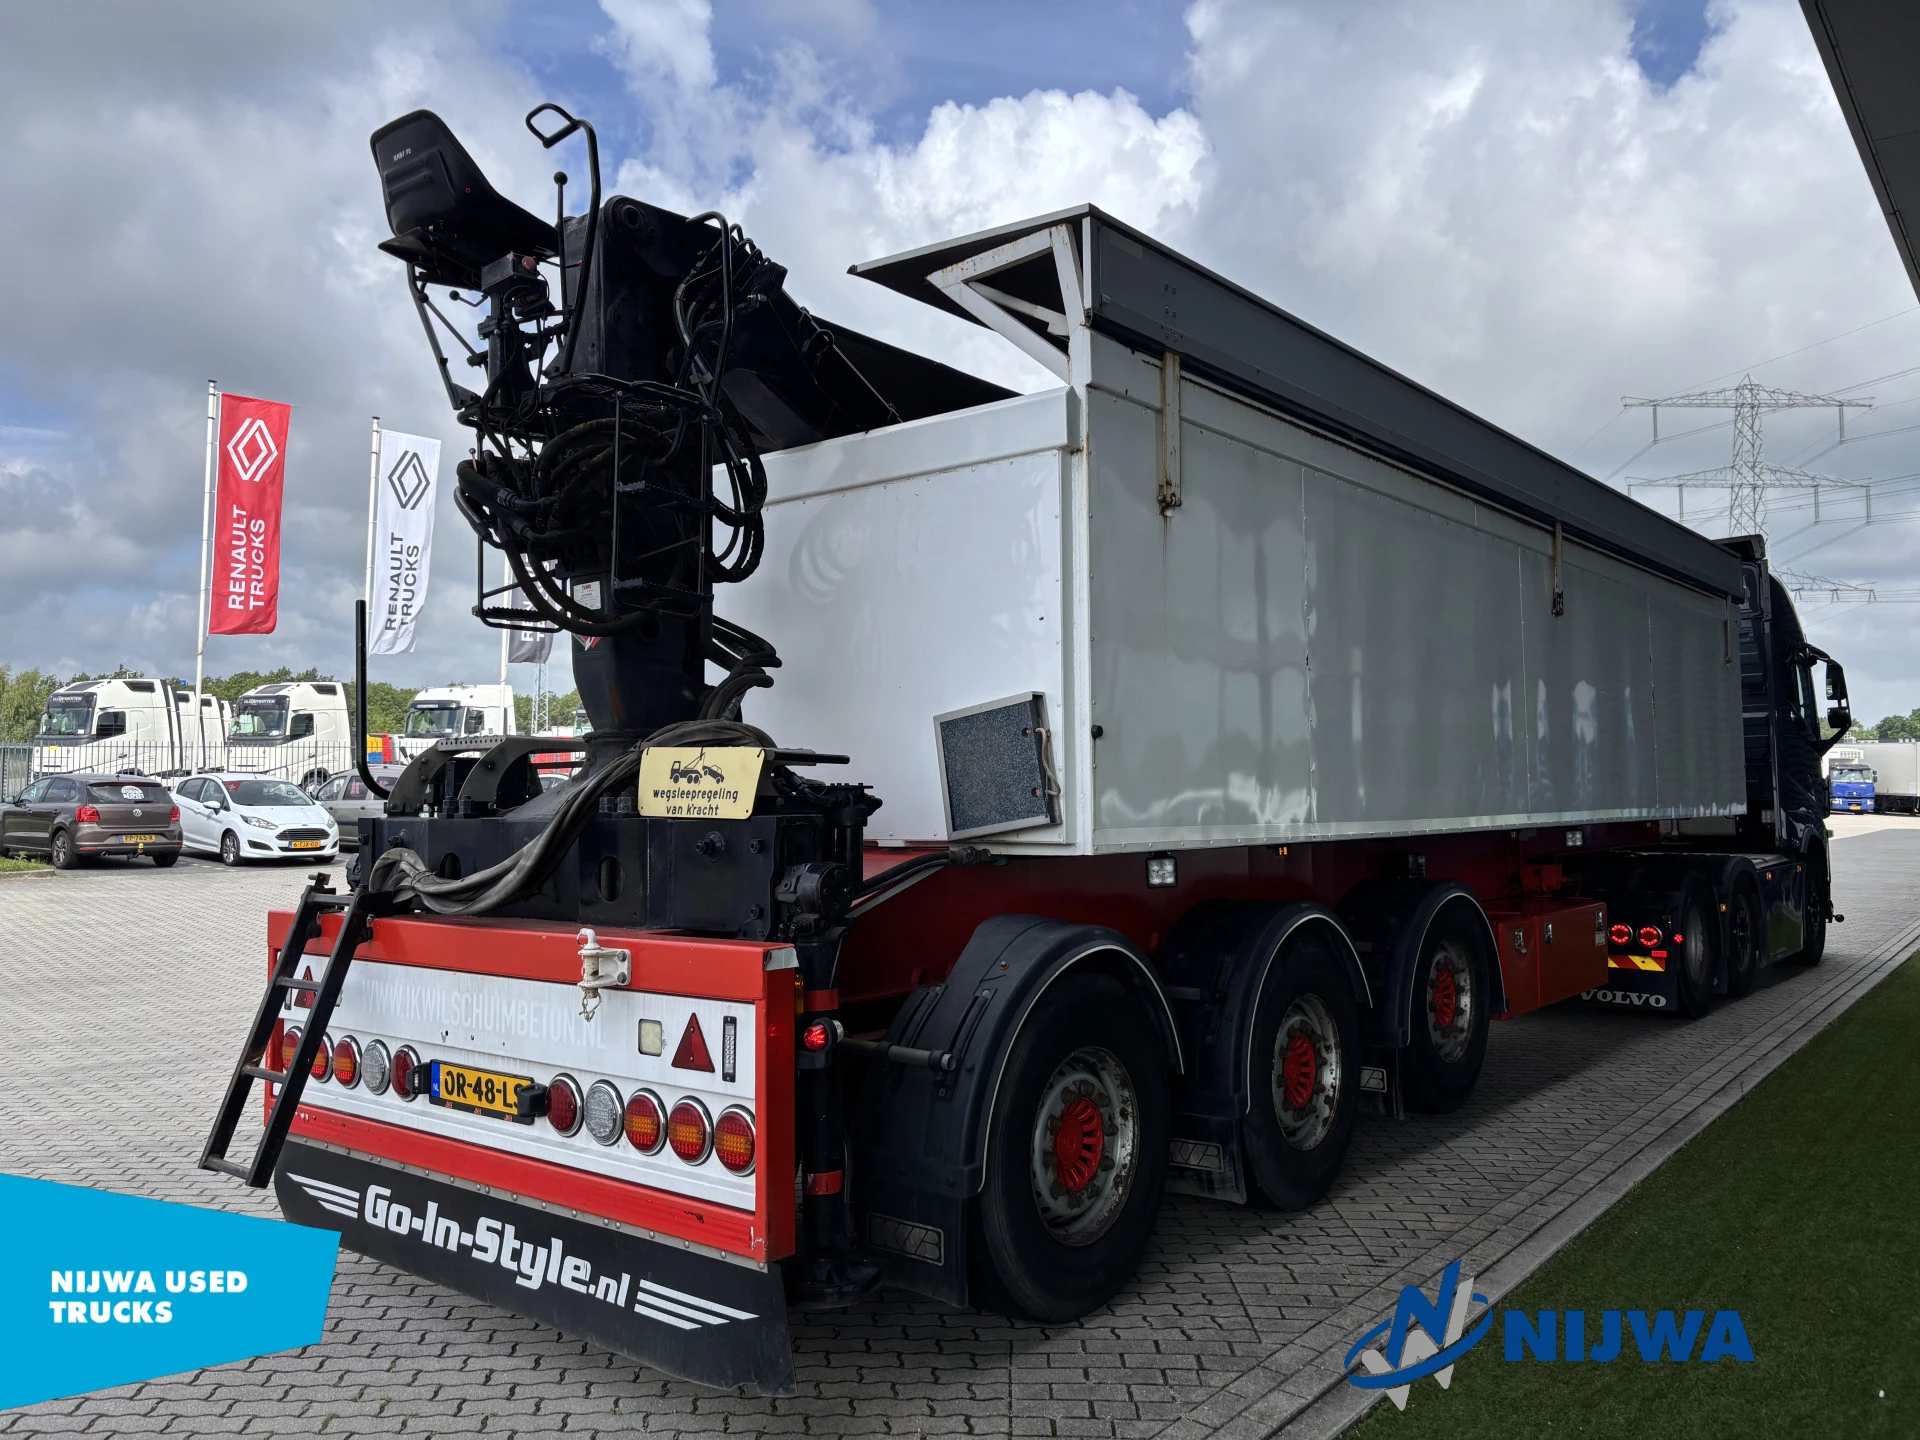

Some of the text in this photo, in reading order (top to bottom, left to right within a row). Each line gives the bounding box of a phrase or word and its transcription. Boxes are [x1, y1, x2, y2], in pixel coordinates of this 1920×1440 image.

[228, 504, 247, 610] RENAULT
[249, 519, 265, 610] TRUCKS
[385, 532, 404, 631] RENAULT
[400, 545, 420, 626] TRUCKS
[653, 787, 739, 804] wegsleepregeling
[666, 803, 720, 817] van kracht
[1580, 989, 1667, 1008] VOLVO
[364, 1184, 631, 1308] Go-In-Style.nl
